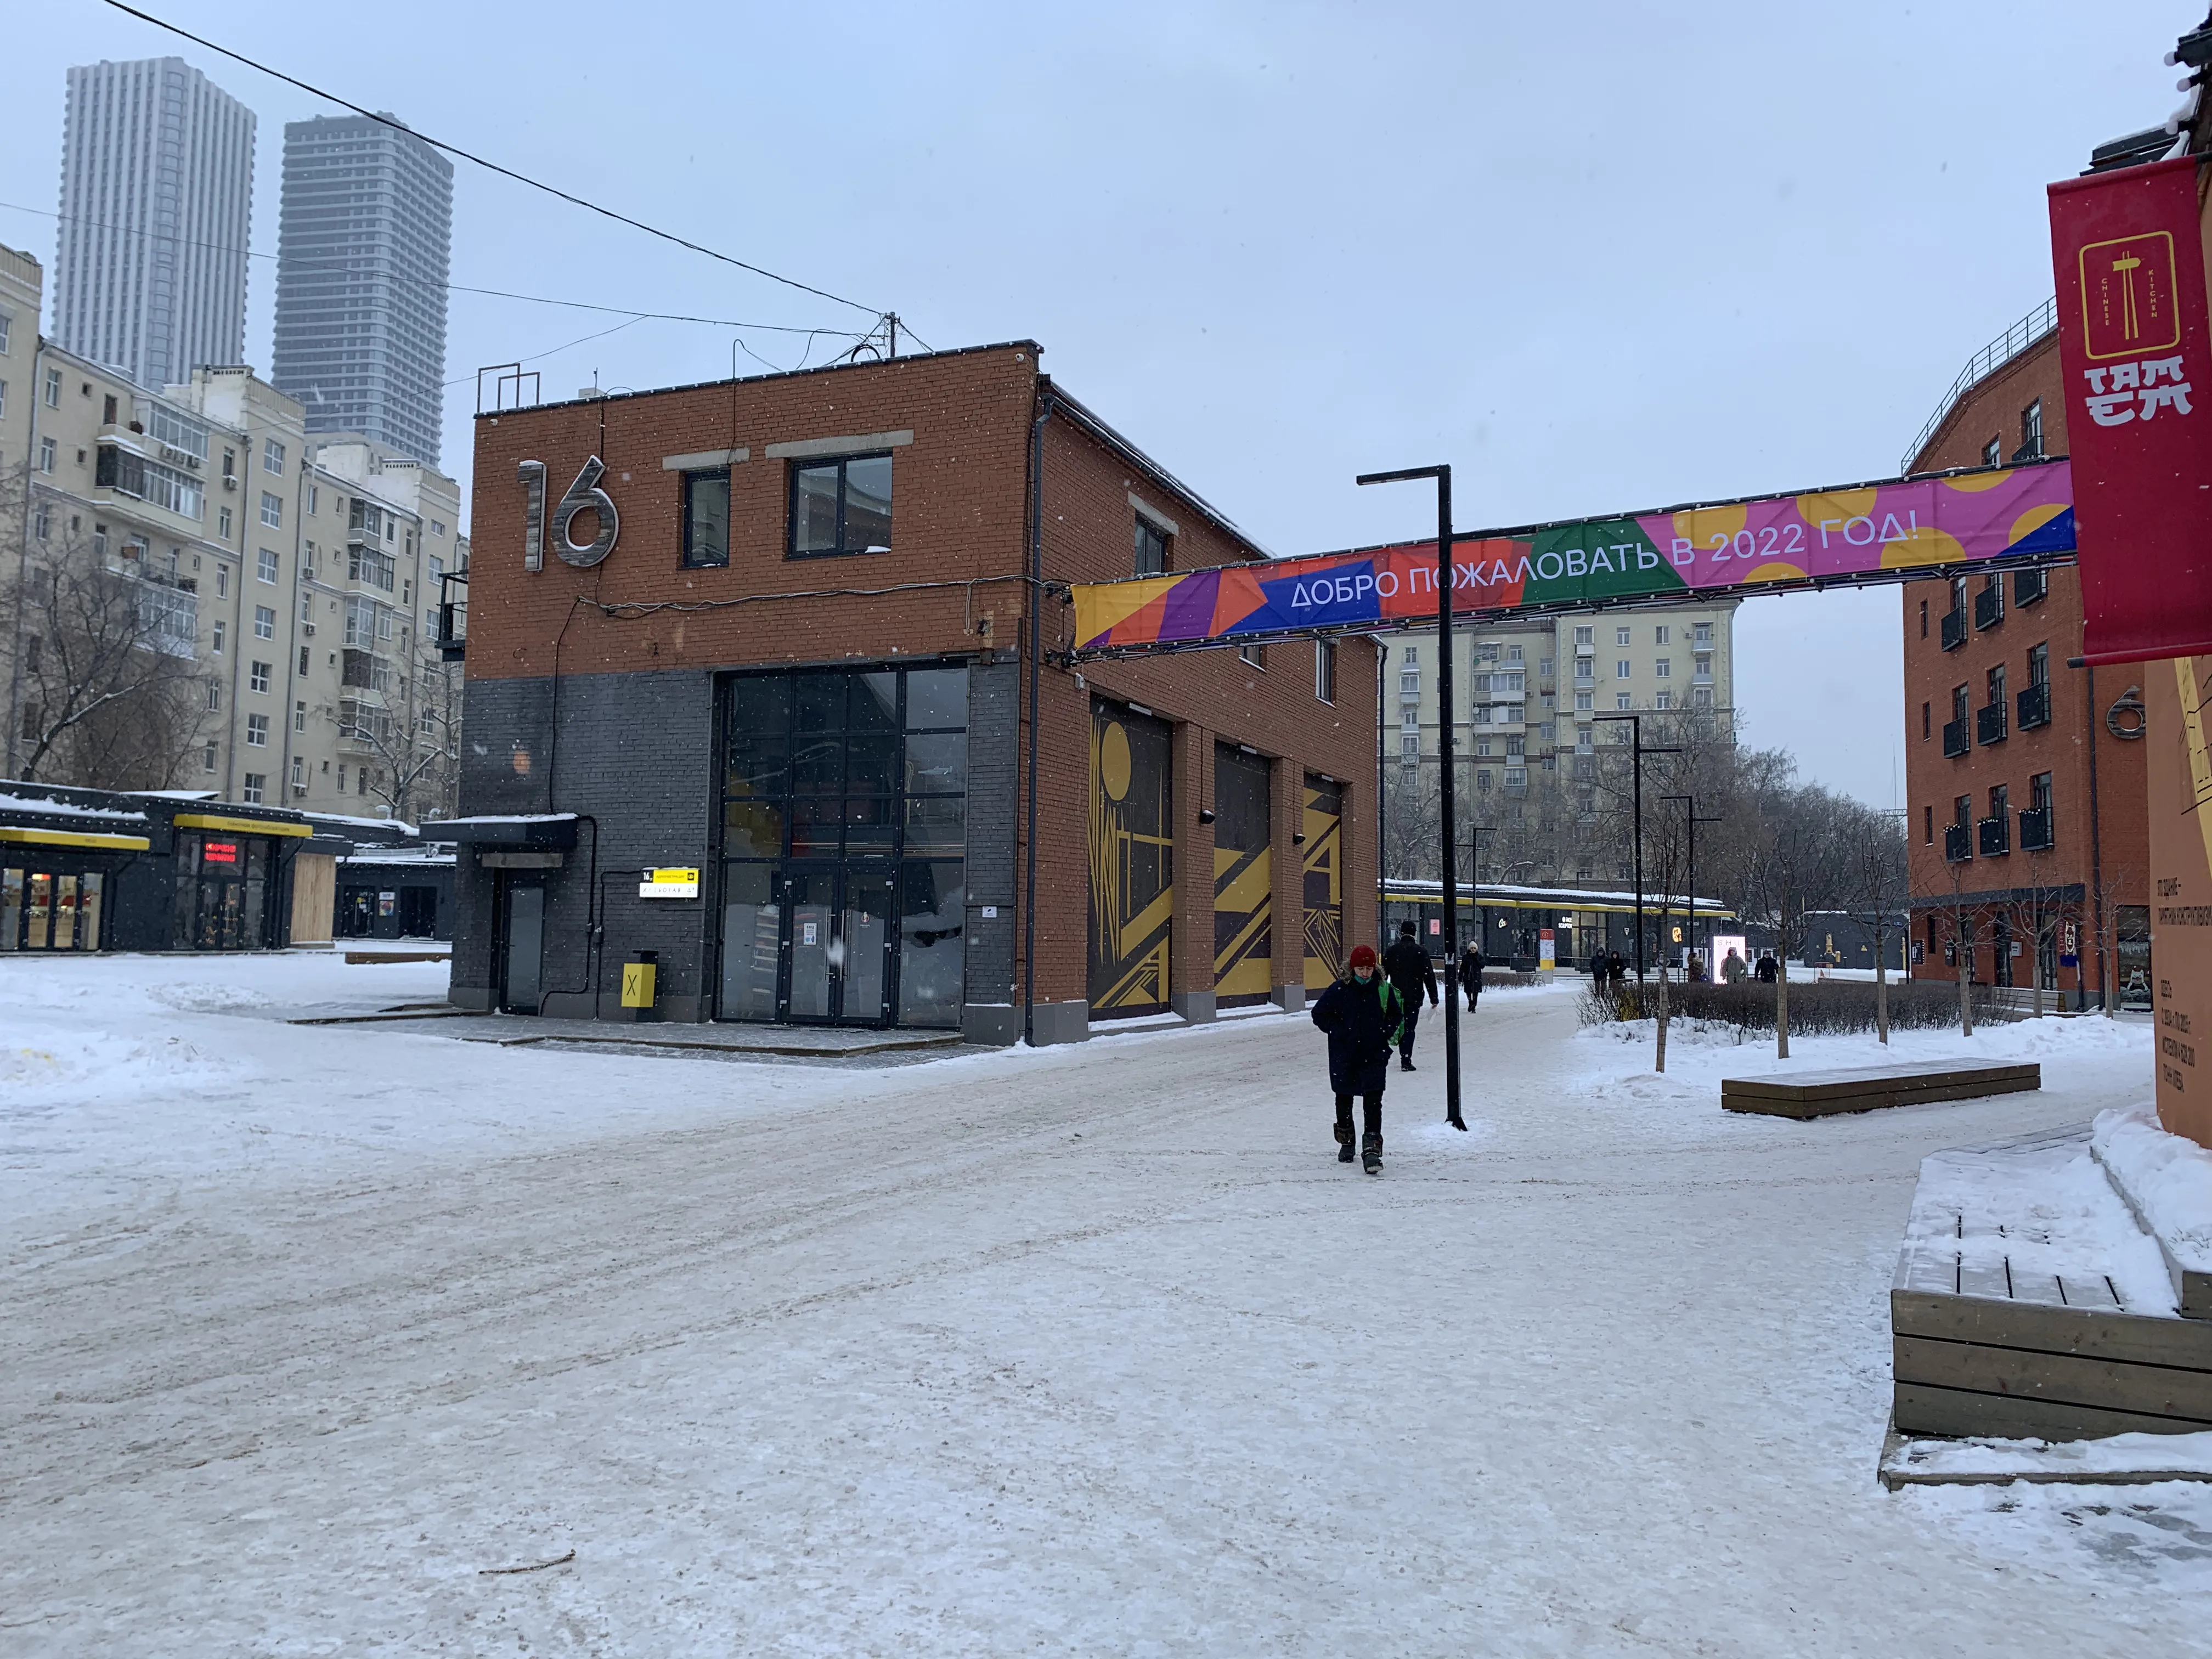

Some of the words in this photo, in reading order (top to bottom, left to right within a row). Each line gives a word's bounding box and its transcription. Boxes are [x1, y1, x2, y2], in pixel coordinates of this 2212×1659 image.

[2101, 278, 2110, 326] CHINESE
[2148, 269, 2158, 318] KITCHEN
[2084, 355, 2184, 394] ТАМ
[517, 454, 619, 572] 16
[1291, 571, 1399, 608] ДОБРО
[1409, 542, 1660, 594] ПОЖАЛОВАТЬ
[1671, 537, 1696, 566] В
[1709, 523, 1805, 562] 2022
[1820, 510, 1918, 549] ГОД!
[643, 872, 650, 881] 16
